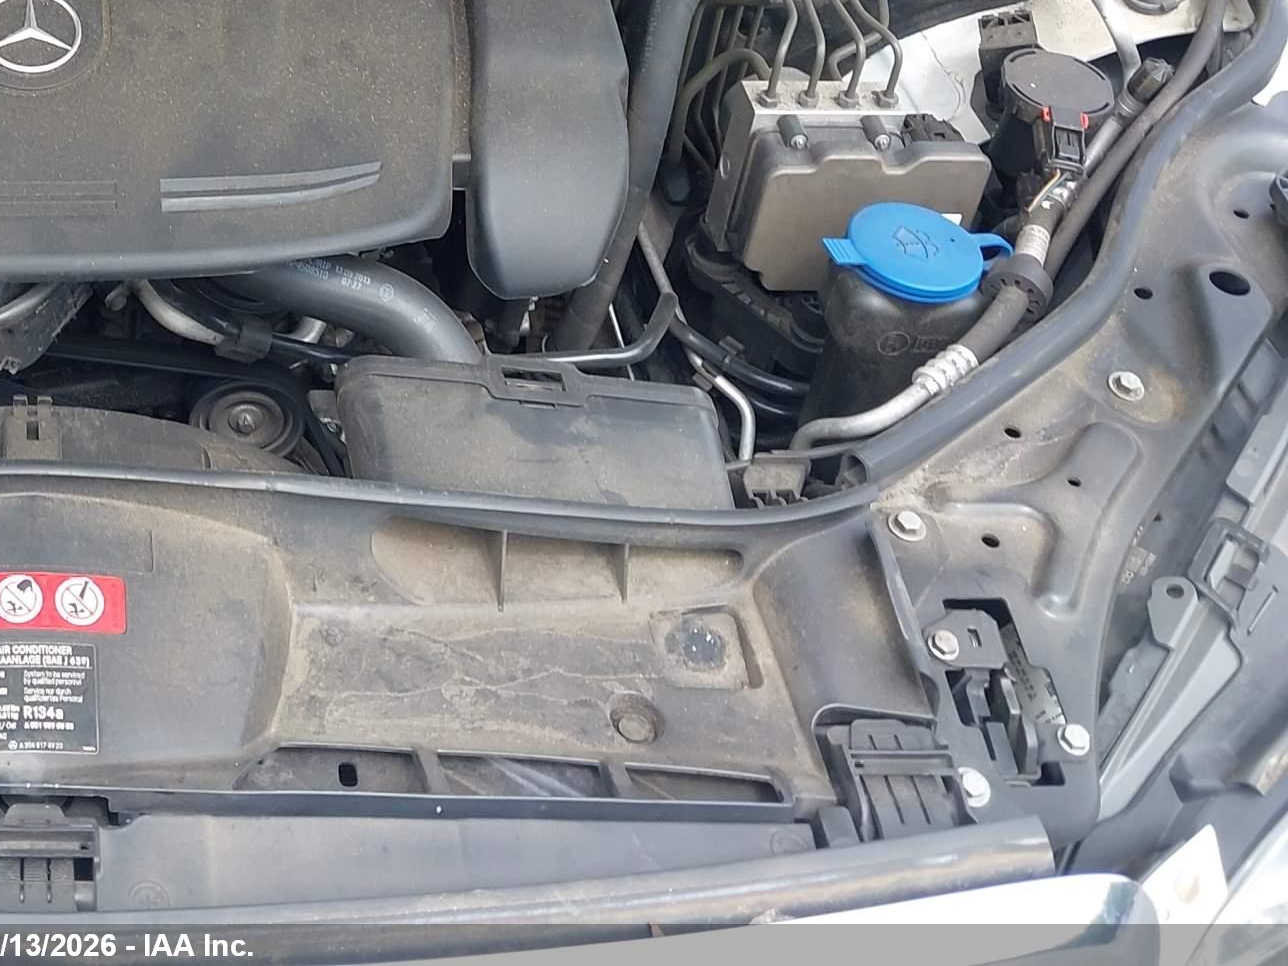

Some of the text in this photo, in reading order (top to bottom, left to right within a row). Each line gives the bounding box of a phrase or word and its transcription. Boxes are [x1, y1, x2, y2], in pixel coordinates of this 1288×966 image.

[12, 645, 73, 655] CONDITIONER
[69, 656, 90, 668] 639)
[24, 670, 45, 679] System
[46, 670, 52, 678] to
[61, 671, 85, 679] serviced
[23, 678, 31, 686] by
[32, 678, 55, 686] qualified
[24, 687, 45, 695] Service
[55, 687, 72, 695] durch
[59, 695, 83, 703] Personal
[23, 705, 64, 720] R134a
